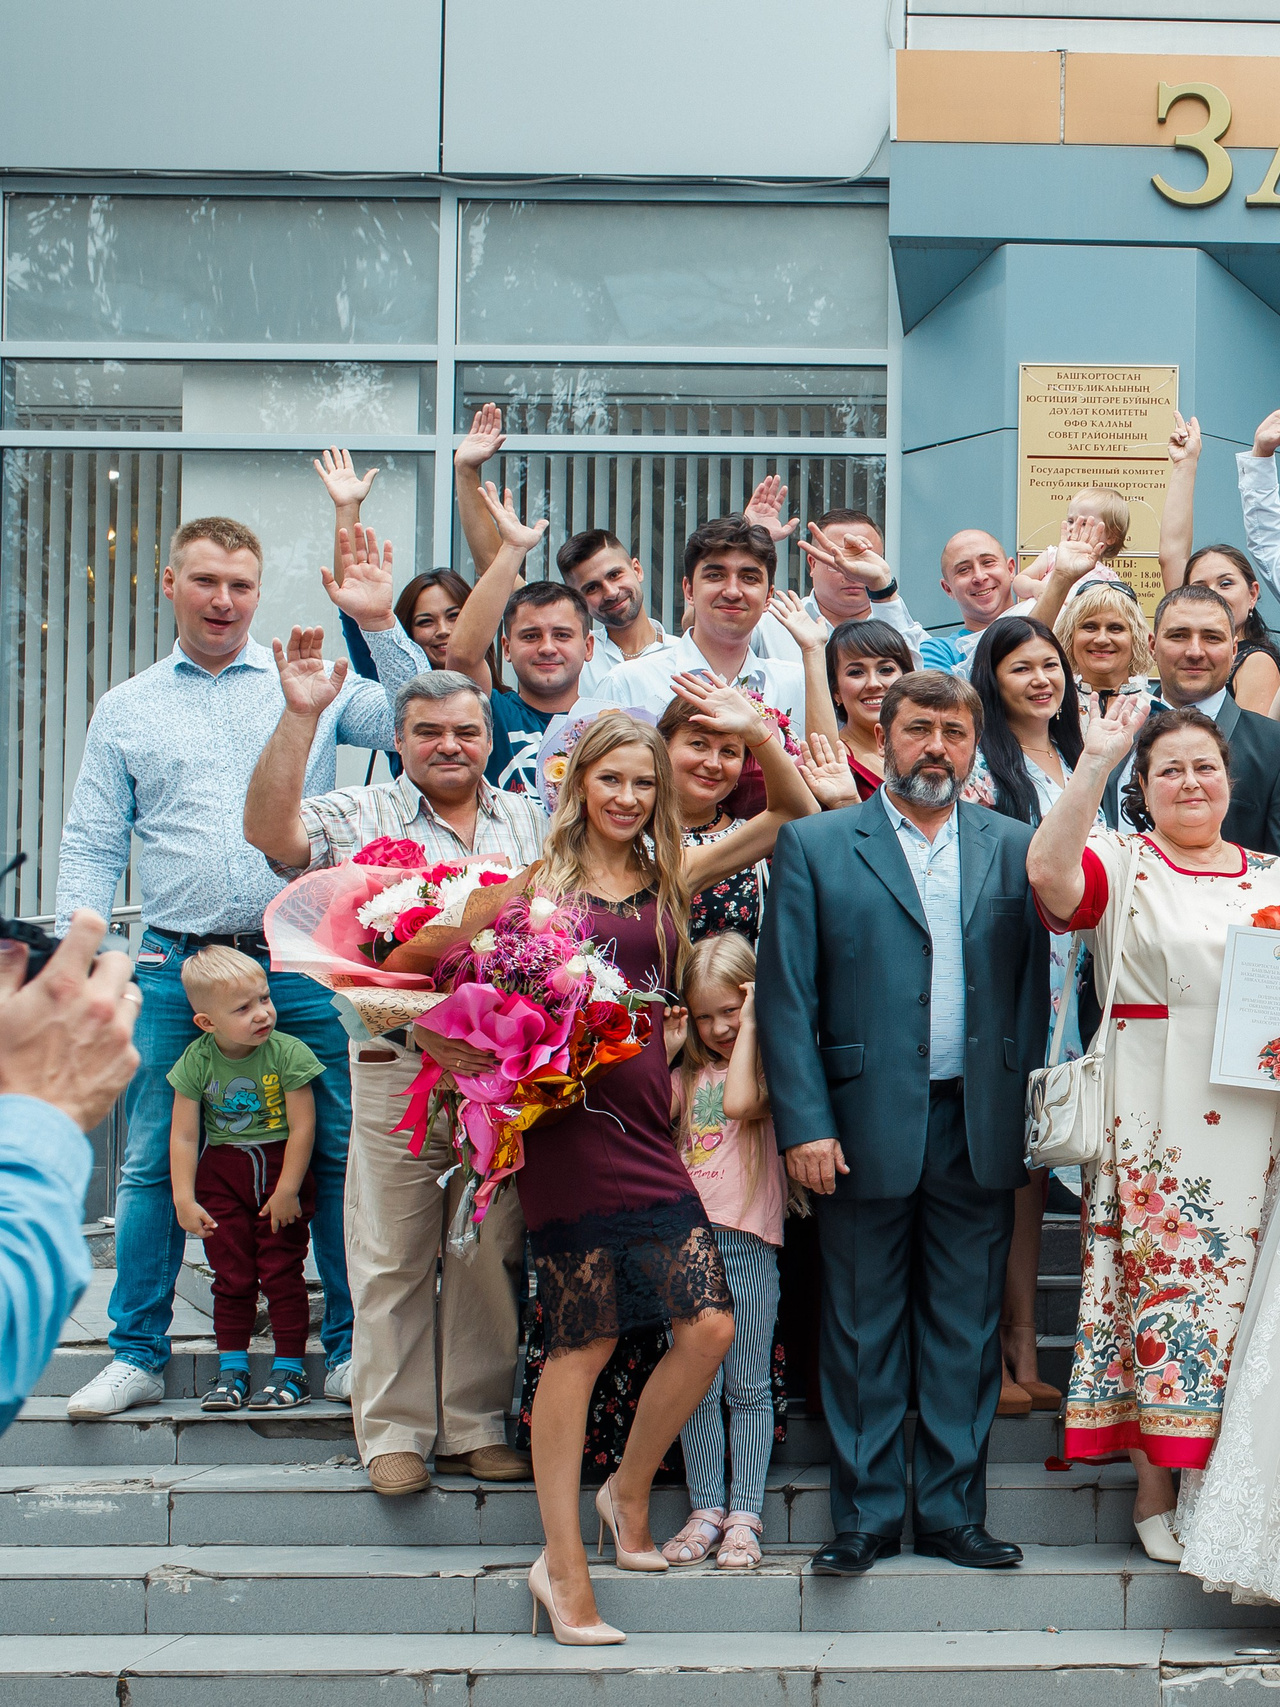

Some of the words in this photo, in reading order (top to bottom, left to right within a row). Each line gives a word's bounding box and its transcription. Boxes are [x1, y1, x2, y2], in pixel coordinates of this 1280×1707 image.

[1026, 395, 1078, 404] ЮСТИЦИЯ
[1123, 395, 1171, 405] БУЙЫНСА
[1092, 408, 1148, 417] КОМИТЕТЫ
[1048, 431, 1080, 440] СОВЕТ
[1068, 443, 1092, 451] ЗАГС
[1030, 465, 1120, 476] Государственный
[1122, 468, 1165, 476] комитет
[1029, 478, 1089, 490] Республики
[1092, 479, 1166, 490] Башкортостан
[1140, 571, 1161, 579] 18.00
[1140, 581, 1161, 589] 14.00
